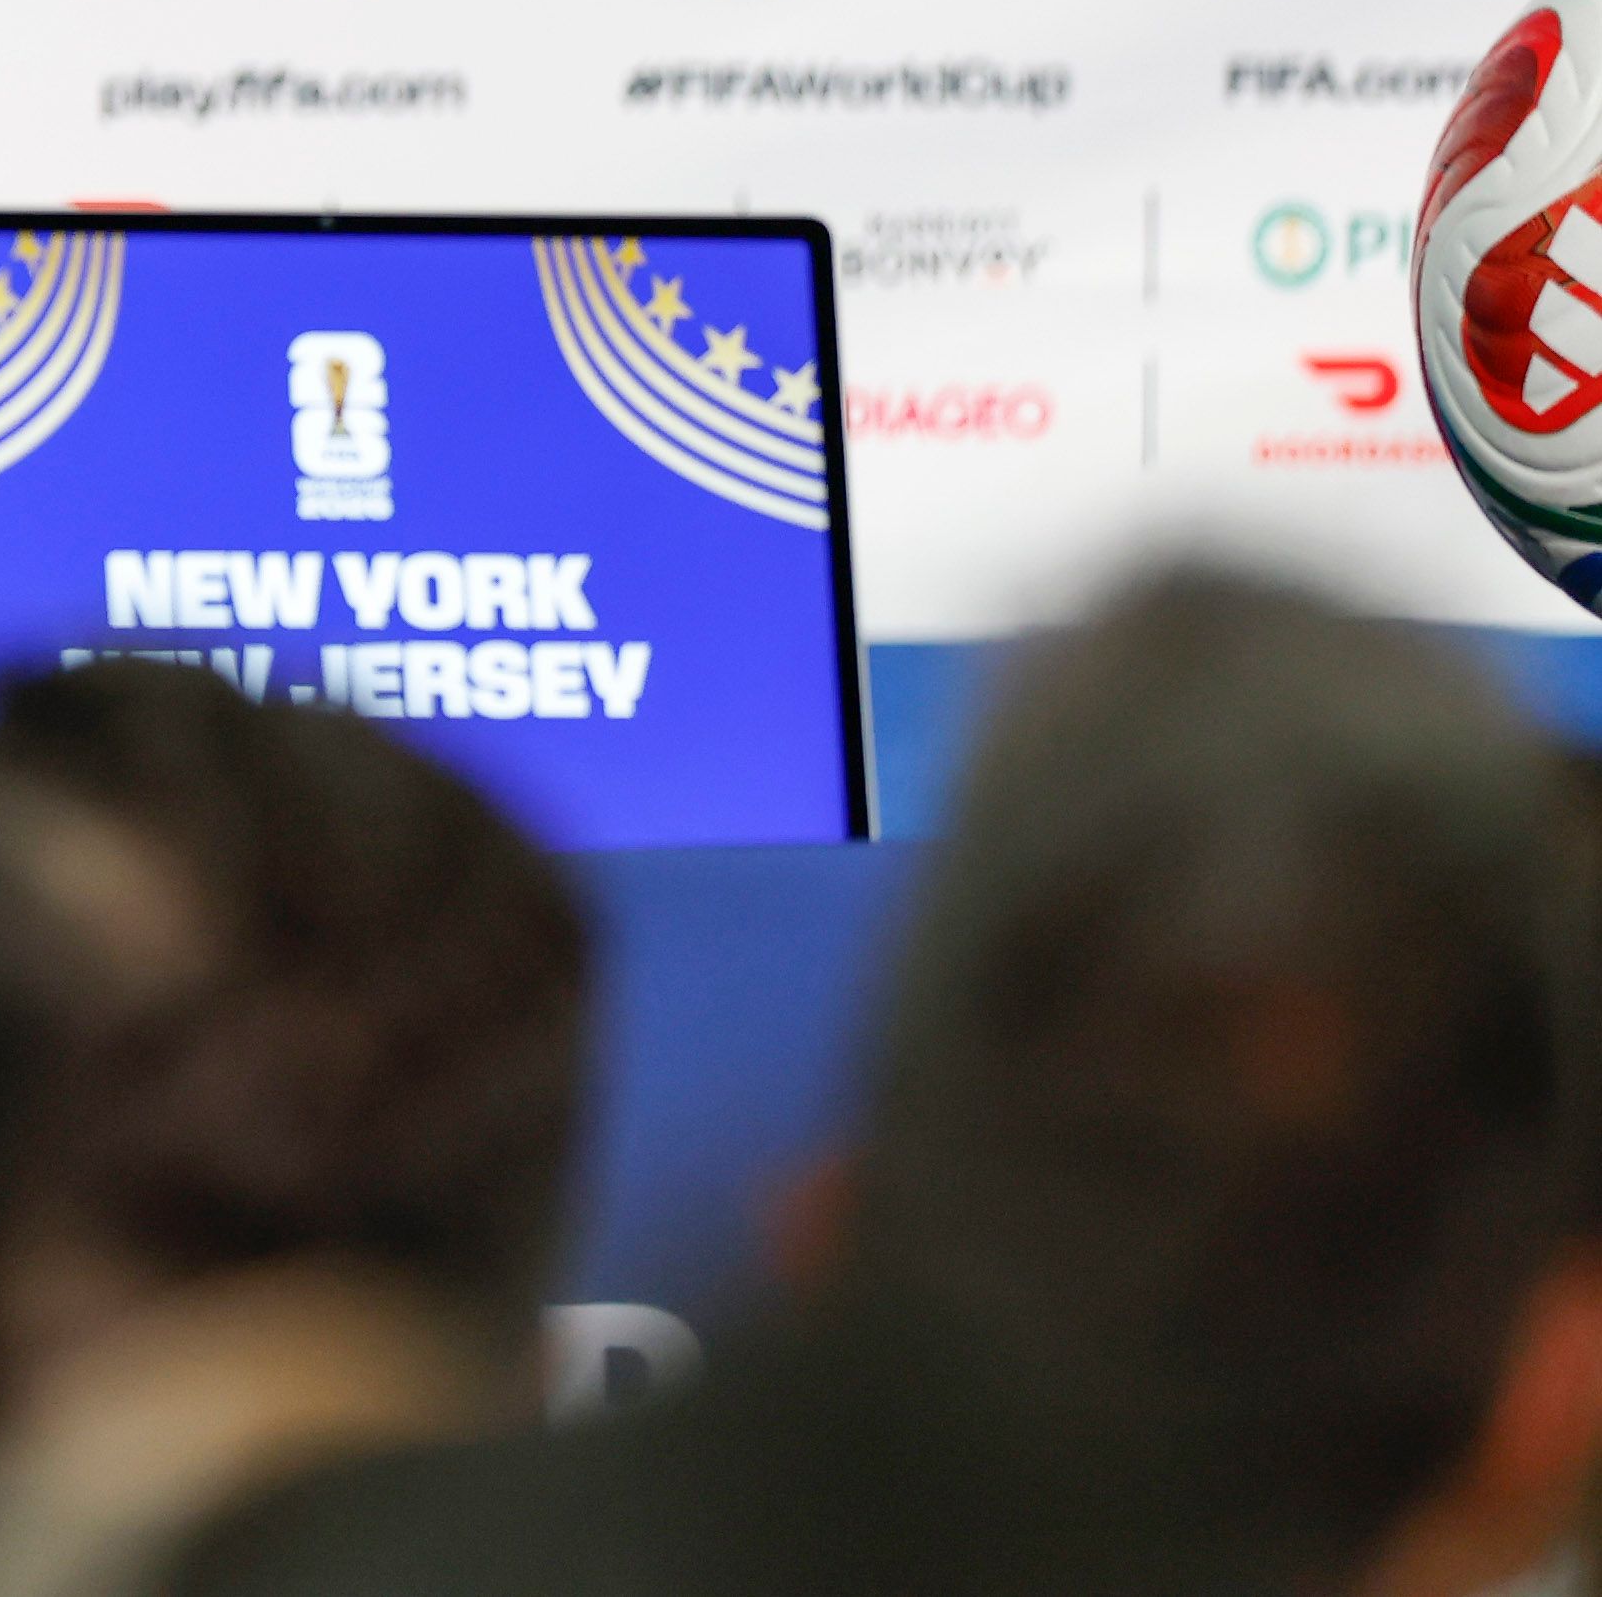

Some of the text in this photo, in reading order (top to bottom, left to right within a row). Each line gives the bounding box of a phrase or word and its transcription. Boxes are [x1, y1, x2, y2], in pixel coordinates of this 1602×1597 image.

[1349, 215, 1411, 270] PI
[851, 388, 1052, 441] DIAGEO
[104, 549, 597, 631] NEW YORK
[290, 640, 652, 720] JERSEY
